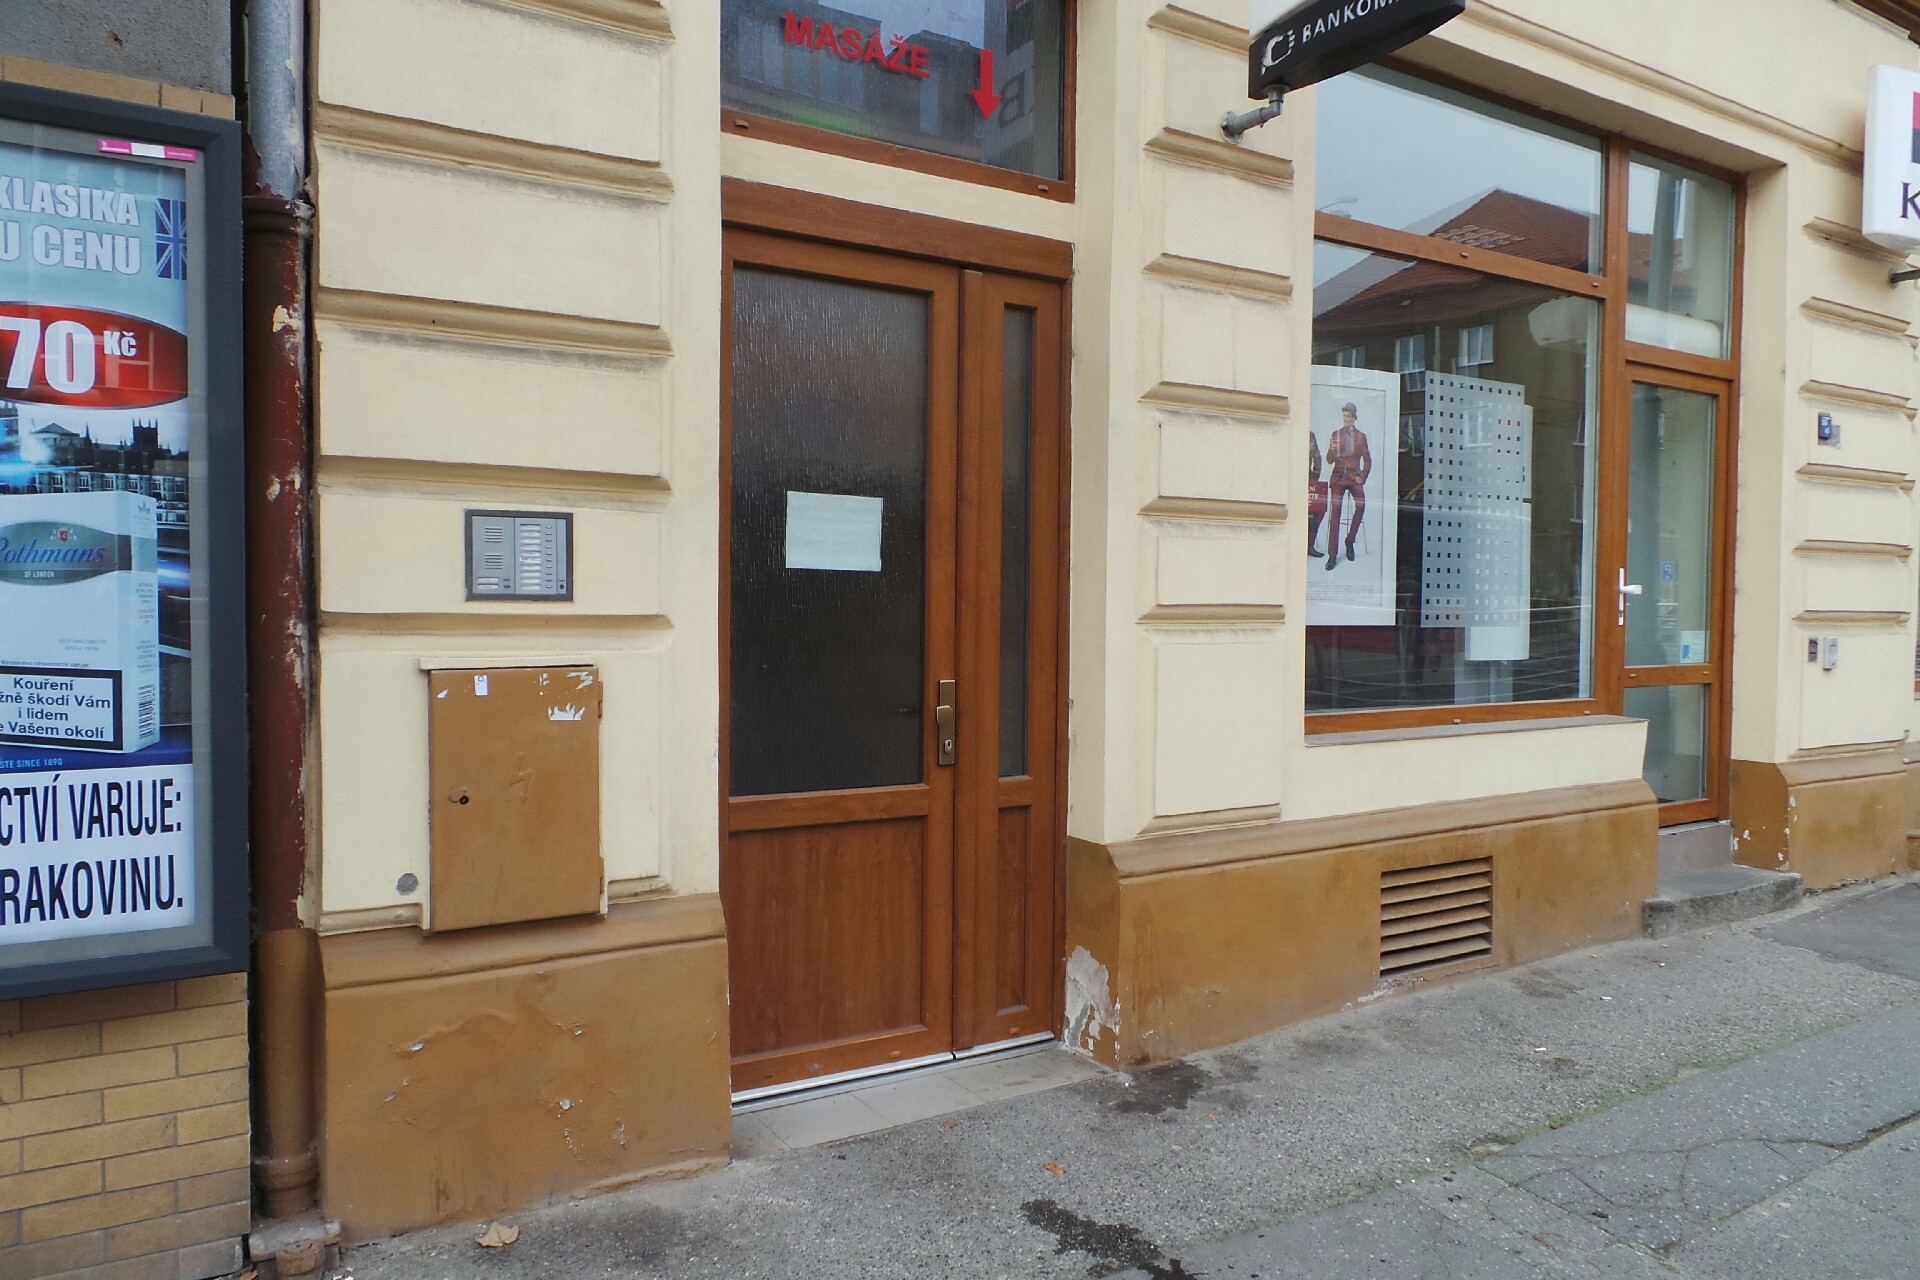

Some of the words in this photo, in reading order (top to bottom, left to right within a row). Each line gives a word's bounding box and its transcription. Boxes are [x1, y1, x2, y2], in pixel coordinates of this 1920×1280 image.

[1302, 0, 1399, 44] BANKO
[784, 11, 931, 78] MASÁŽE
[32, 224, 141, 275] CENU
[104, 330, 137, 357] Kč
[33, 570, 55, 578] LONDON
[13, 678, 74, 691] Kouření
[27, 692, 70, 706] škodí
[75, 694, 111, 709] Vám
[18, 707, 22, 719] i
[27, 708, 69, 721] lidem
[8, 721, 59, 736] Vašem
[65, 725, 105, 739] okolí
[16, 759, 41, 768] SINCE
[44, 758, 63, 766] 1890
[0, 773, 61, 847] CTVÍ
[68, 778, 181, 840] VARUJE:
[0, 854, 184, 926] RAKOVINU.
